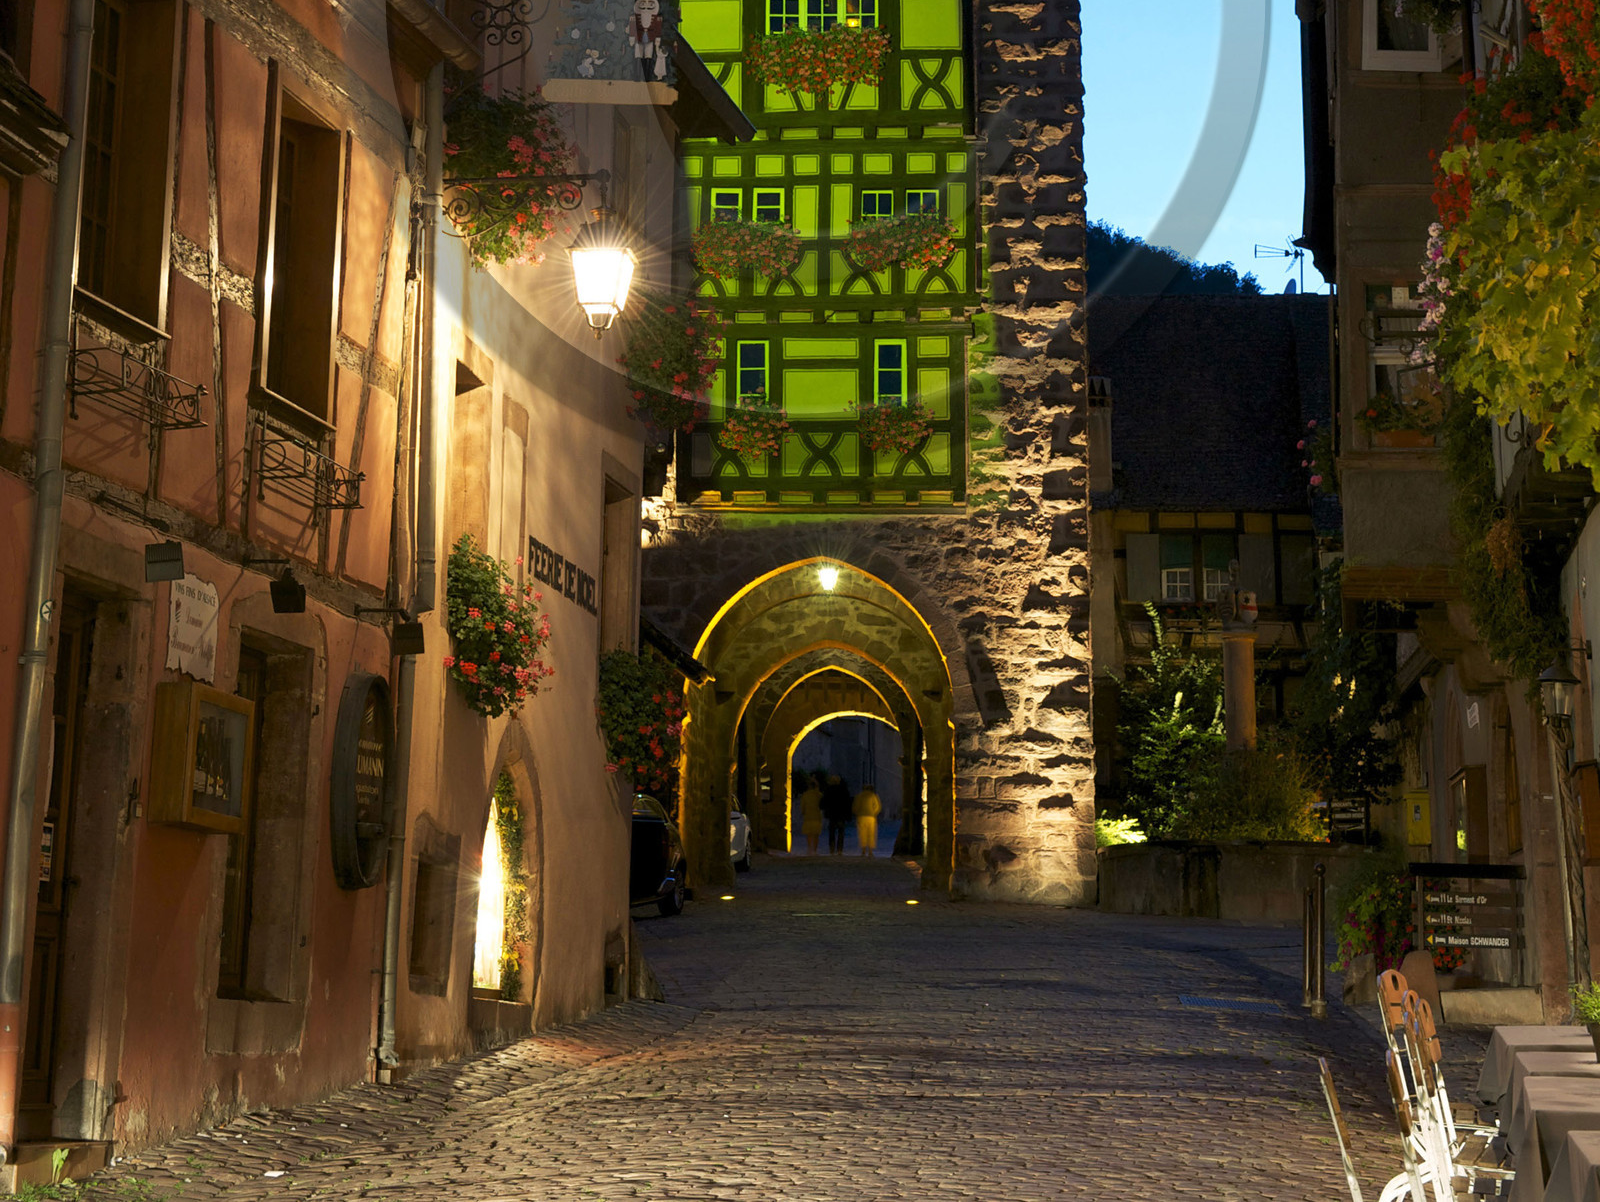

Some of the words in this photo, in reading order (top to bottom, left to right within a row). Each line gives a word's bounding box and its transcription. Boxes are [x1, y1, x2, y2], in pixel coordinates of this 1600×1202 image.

[529, 535, 563, 594] FEERIE
[564, 559, 576, 603] DE
[577, 568, 598, 617] NOEL
[356, 754, 384, 777] UMANN
[1446, 894, 1453, 904] Le
[1448, 936, 1469, 945] Maison
[1470, 936, 1510, 947] SCHWANDER
